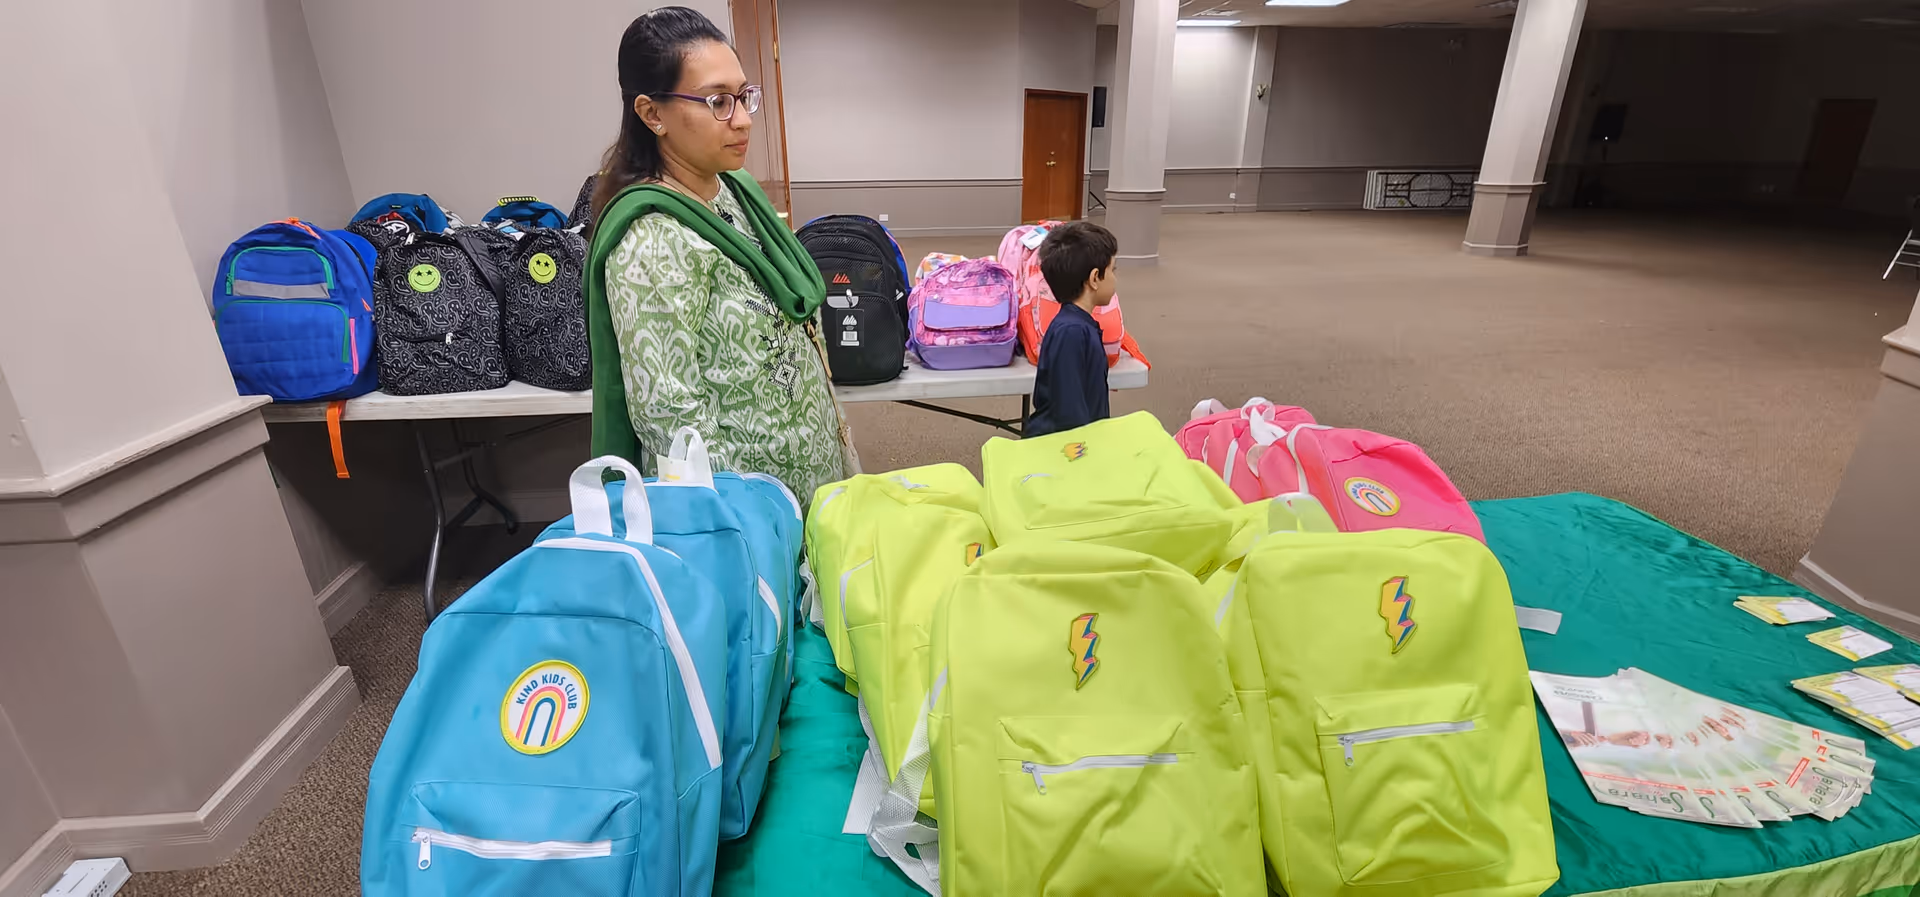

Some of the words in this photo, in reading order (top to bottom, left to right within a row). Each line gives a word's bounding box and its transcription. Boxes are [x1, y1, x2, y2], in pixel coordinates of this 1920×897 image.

[516, 679, 538, 705] KIND
[541, 673, 566, 686] KIDS
[564, 683, 578, 709] CLUB
[1608, 788, 1684, 813] Sahara
